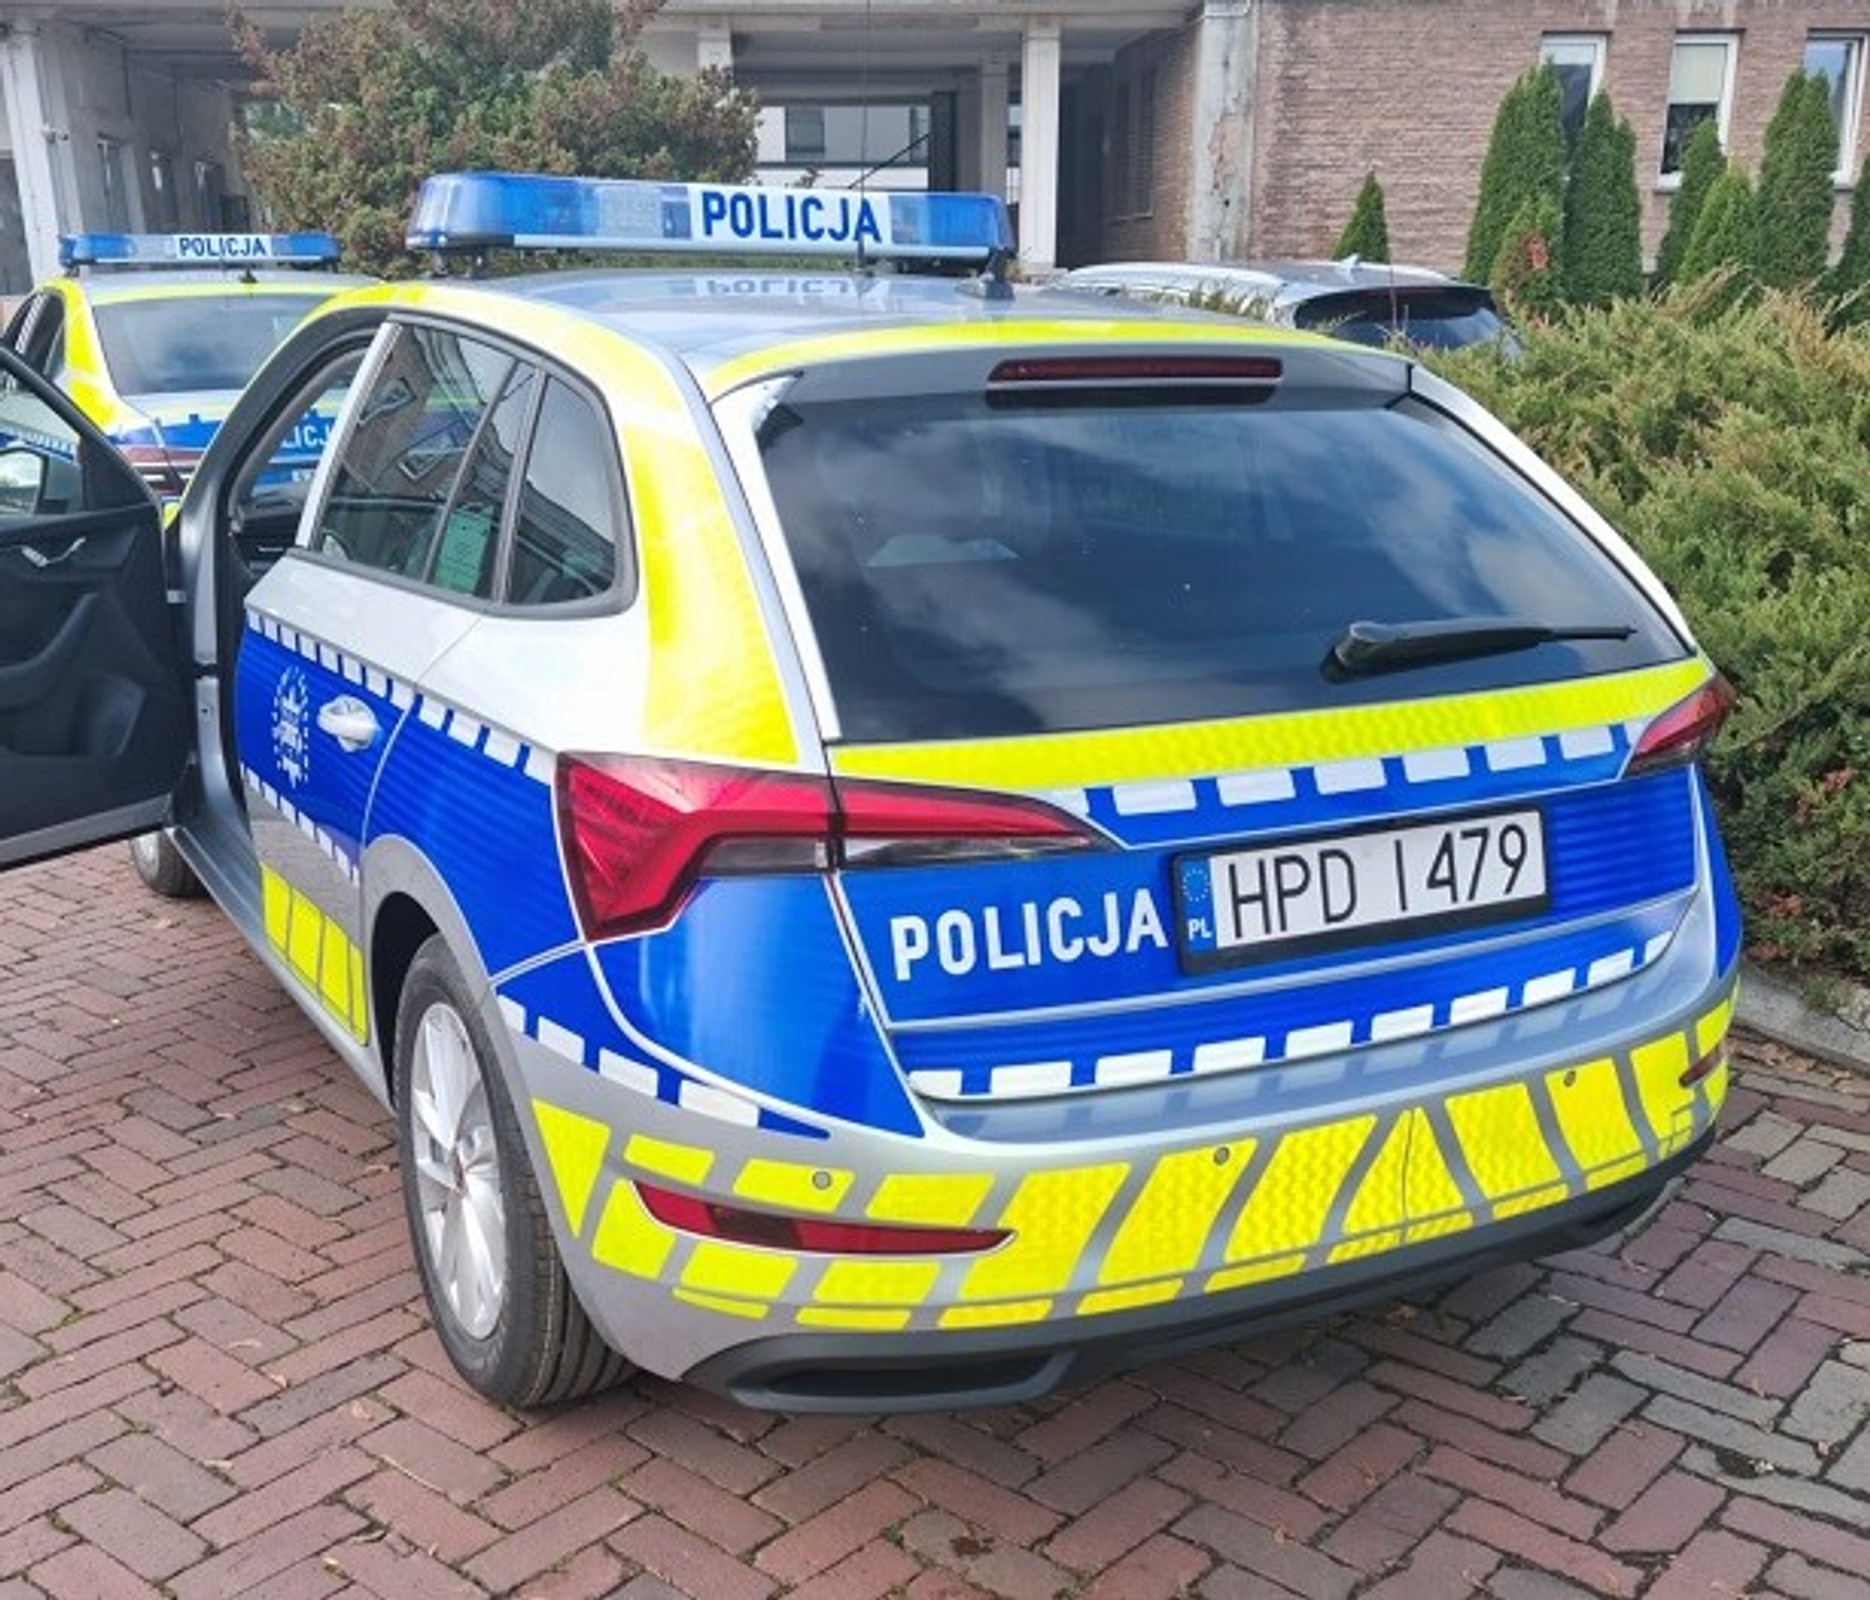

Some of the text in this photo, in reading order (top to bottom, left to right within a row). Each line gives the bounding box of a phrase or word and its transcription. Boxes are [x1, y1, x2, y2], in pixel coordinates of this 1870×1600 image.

[702, 191, 882, 243] POLICJA
[179, 237, 267, 256] POLICJA
[1228, 849, 1357, 938] HPD
[890, 888, 1168, 980] POLICJA
[1187, 918, 1211, 941] PL
